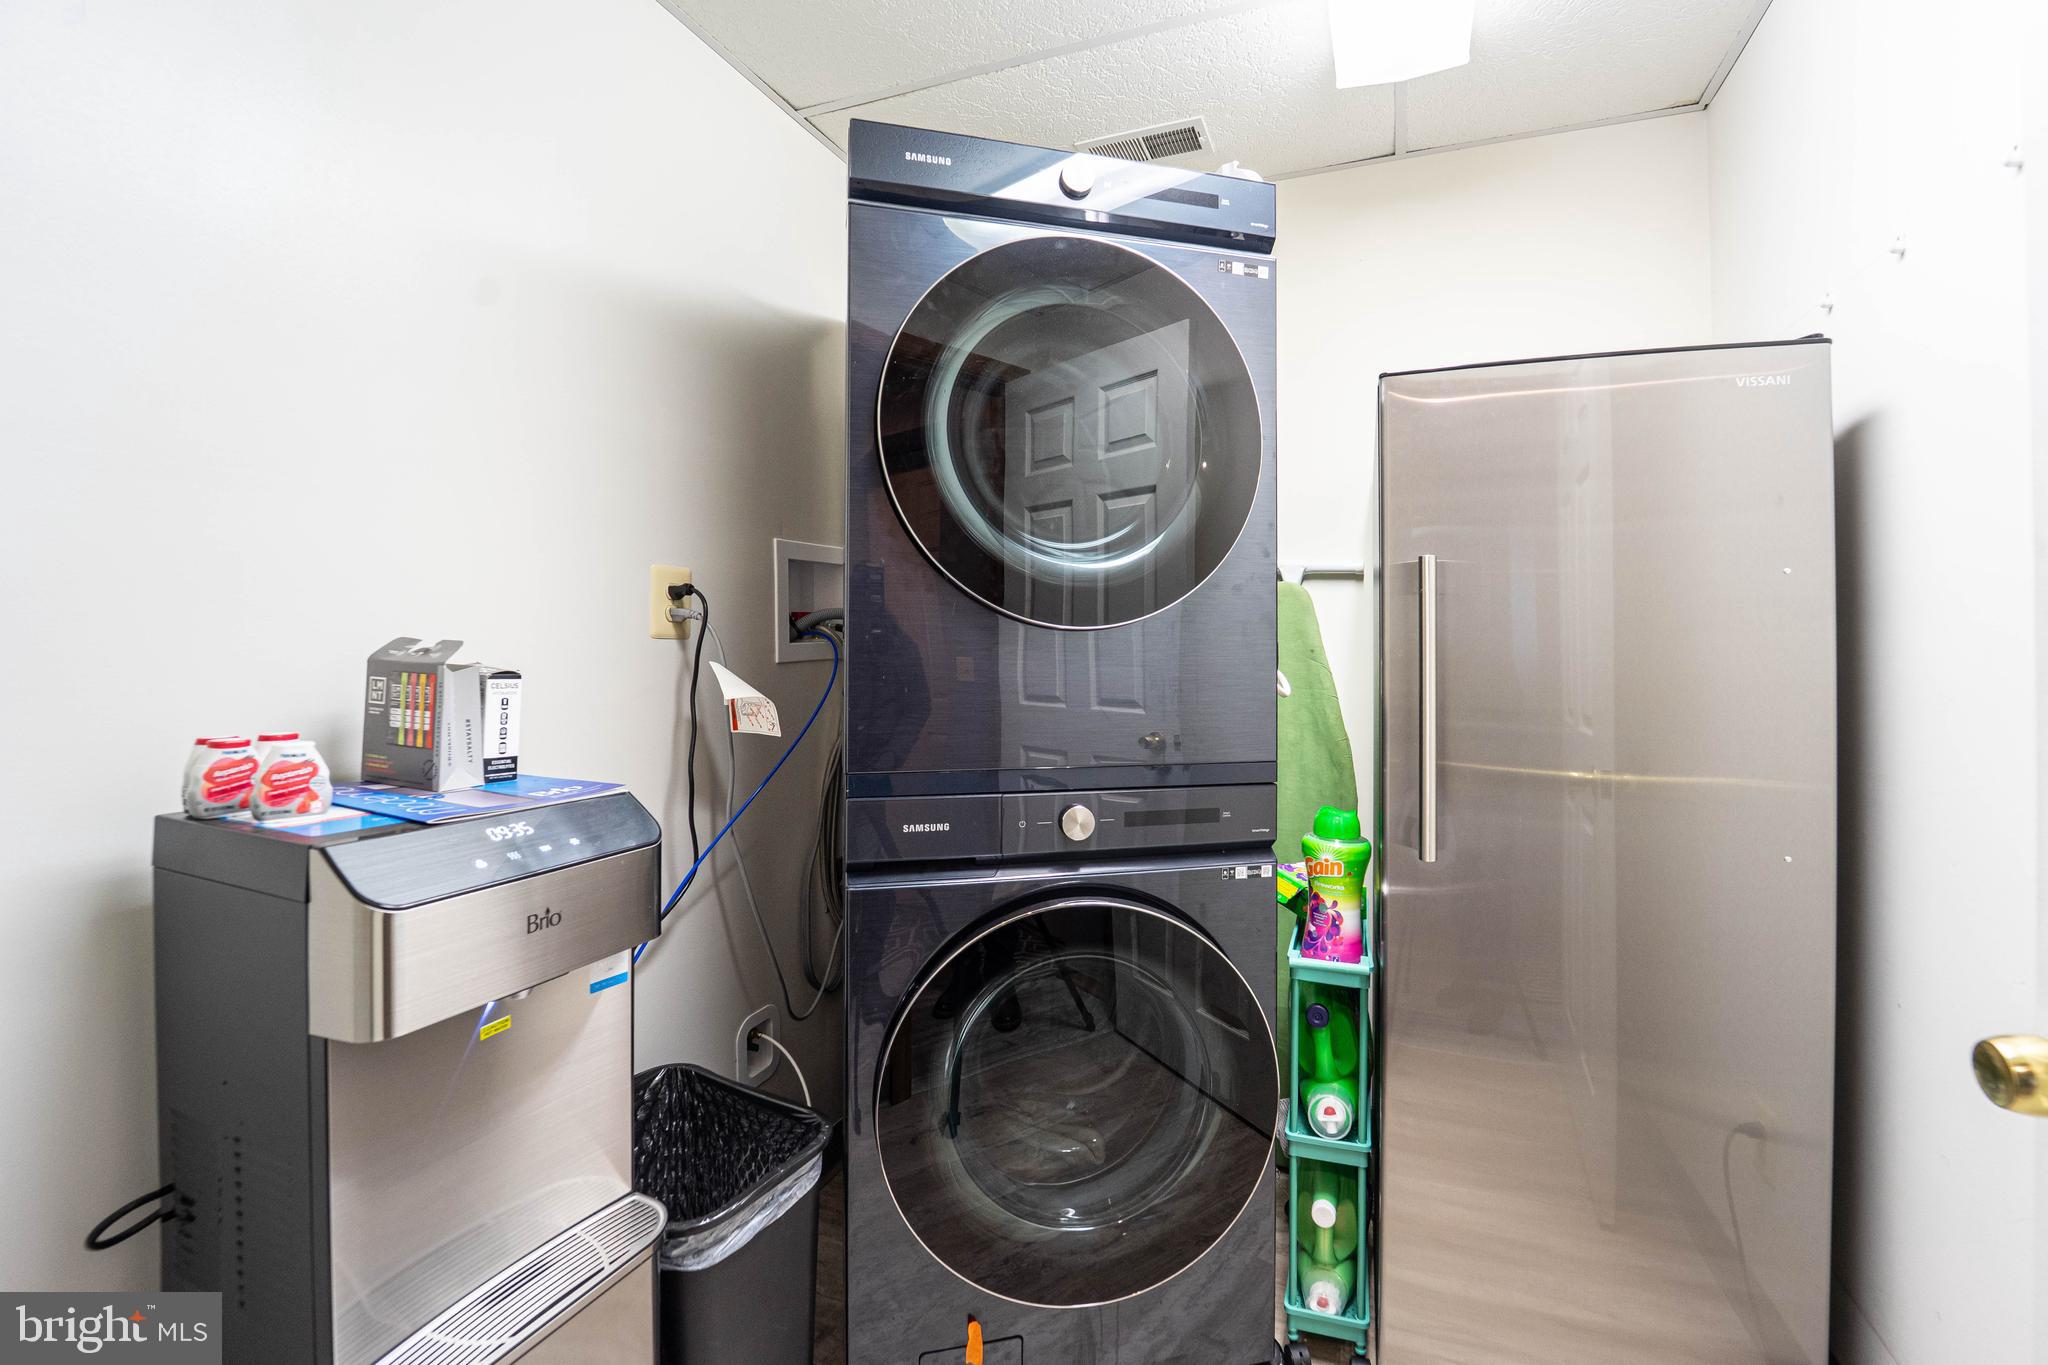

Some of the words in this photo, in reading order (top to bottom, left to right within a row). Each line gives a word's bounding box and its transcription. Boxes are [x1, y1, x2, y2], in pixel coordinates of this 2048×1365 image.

[905, 151, 952, 166] SAMSUNG
[1735, 374, 1792, 387] VISSANI
[902, 822, 950, 833] SAMSUNG
[1305, 856, 1344, 877] Gain
[527, 906, 562, 935] Brio
